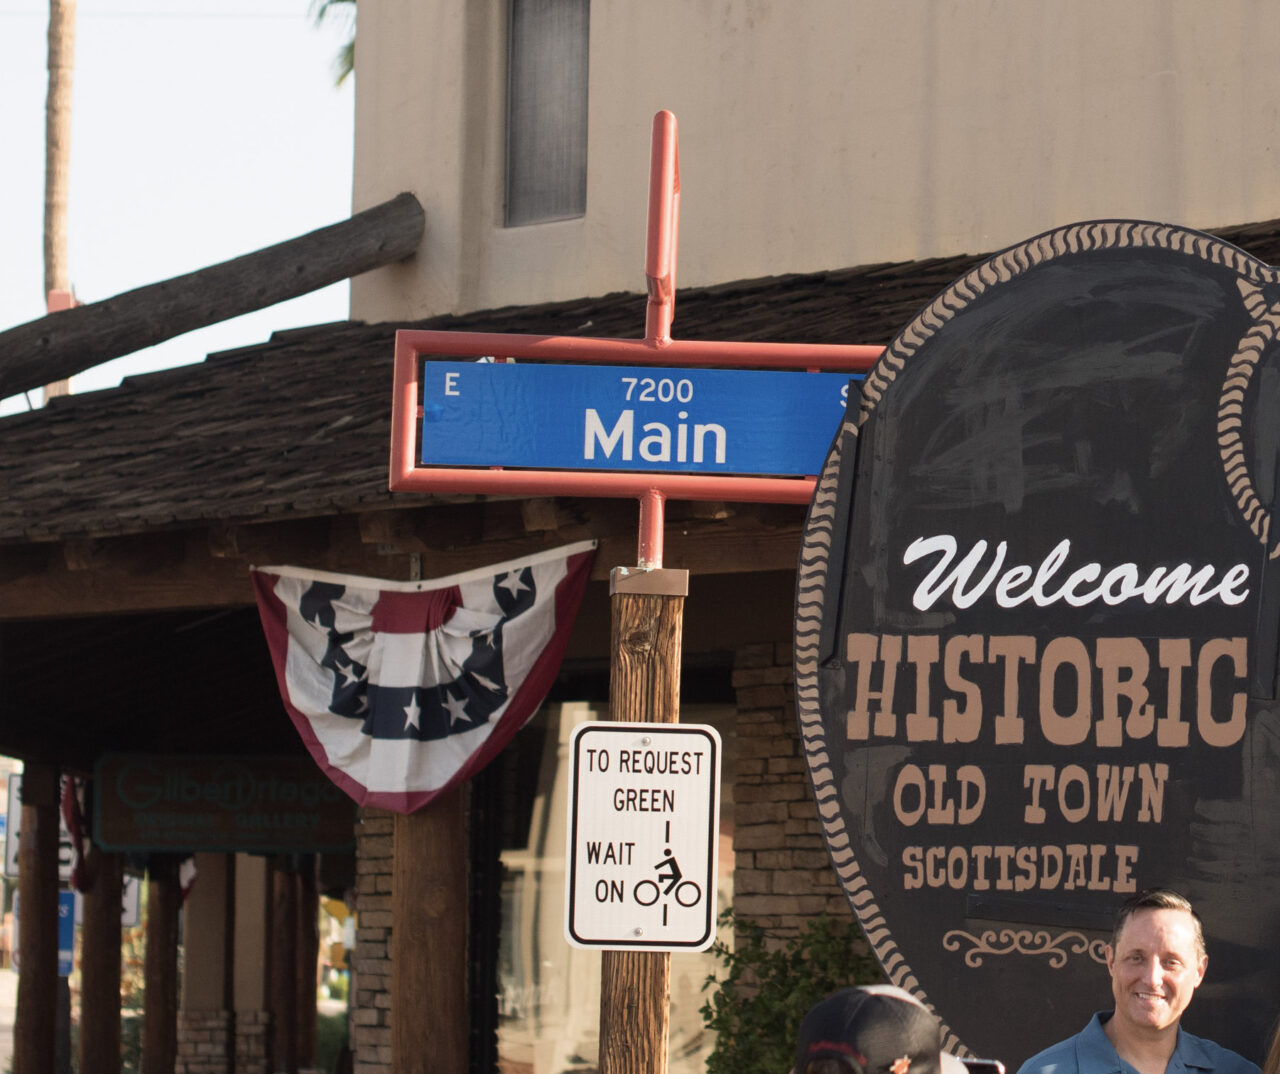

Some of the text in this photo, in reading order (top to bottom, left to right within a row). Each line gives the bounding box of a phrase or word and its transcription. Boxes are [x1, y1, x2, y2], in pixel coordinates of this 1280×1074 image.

[444, 372, 460, 396] E
[621, 377, 694, 403] 7200
[584, 408, 727, 464] Main
[902, 534, 1250, 611] Welcome
[846, 632, 1249, 748] HISTORIC
[587, 749, 704, 775] TO REQUEST
[613, 788, 675, 812] GREEN
[892, 762, 1170, 827] OLD TOWN
[586, 841, 636, 866] WAIT
[902, 844, 1140, 893] SCOTTSDALE
[595, 879, 624, 903] ON
